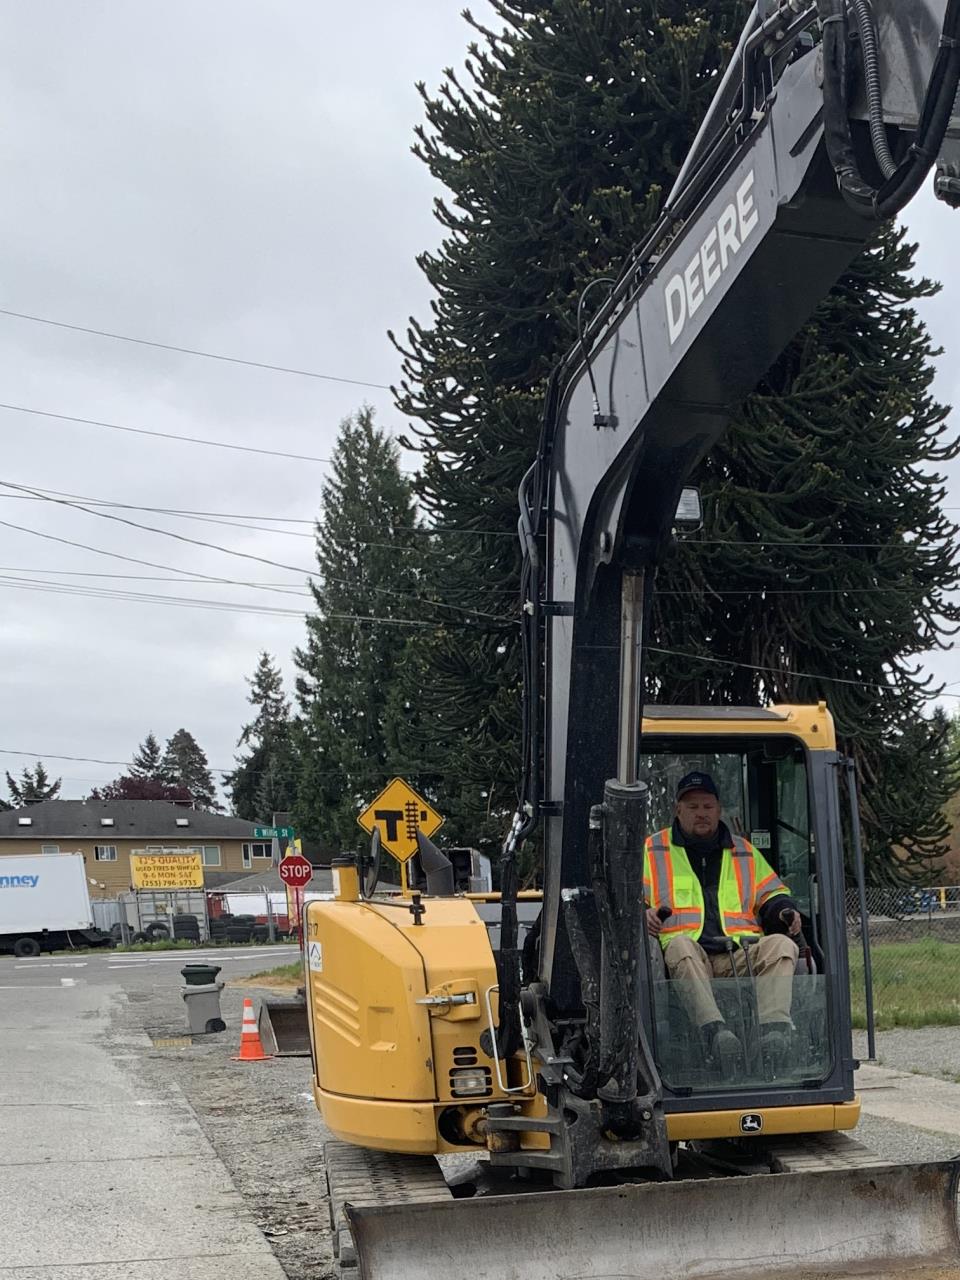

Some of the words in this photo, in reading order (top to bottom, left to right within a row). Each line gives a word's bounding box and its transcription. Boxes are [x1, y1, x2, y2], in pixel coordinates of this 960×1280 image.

[665, 169, 759, 346] DEERE
[282, 828, 288, 837] St
[158, 856, 196, 865] QUALITY
[281, 865, 310, 878] STOP
